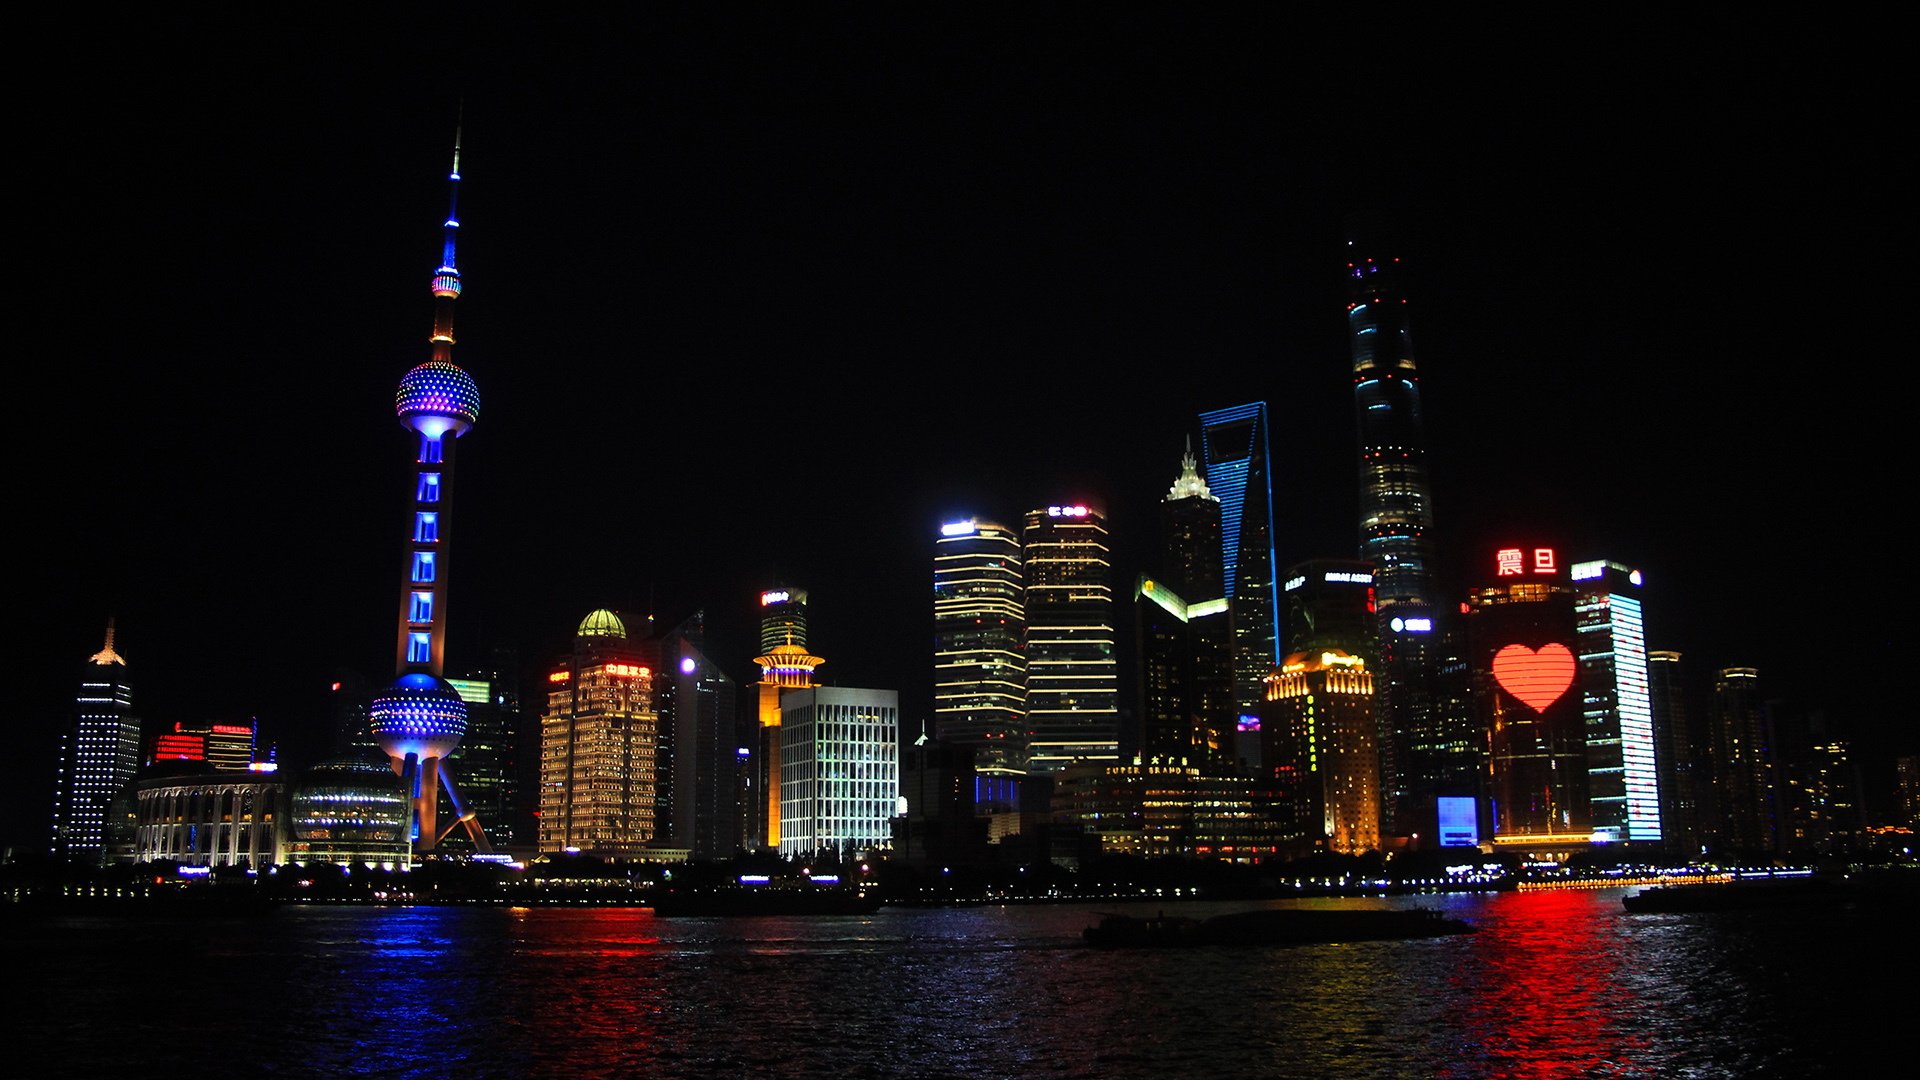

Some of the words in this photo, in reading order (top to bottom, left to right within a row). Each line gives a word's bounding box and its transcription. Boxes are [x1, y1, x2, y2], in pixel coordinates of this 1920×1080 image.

[1498, 549, 1556, 576] 震旦
[1106, 767, 1141, 775] SUPER
[1149, 767, 1181, 775] BRAND
